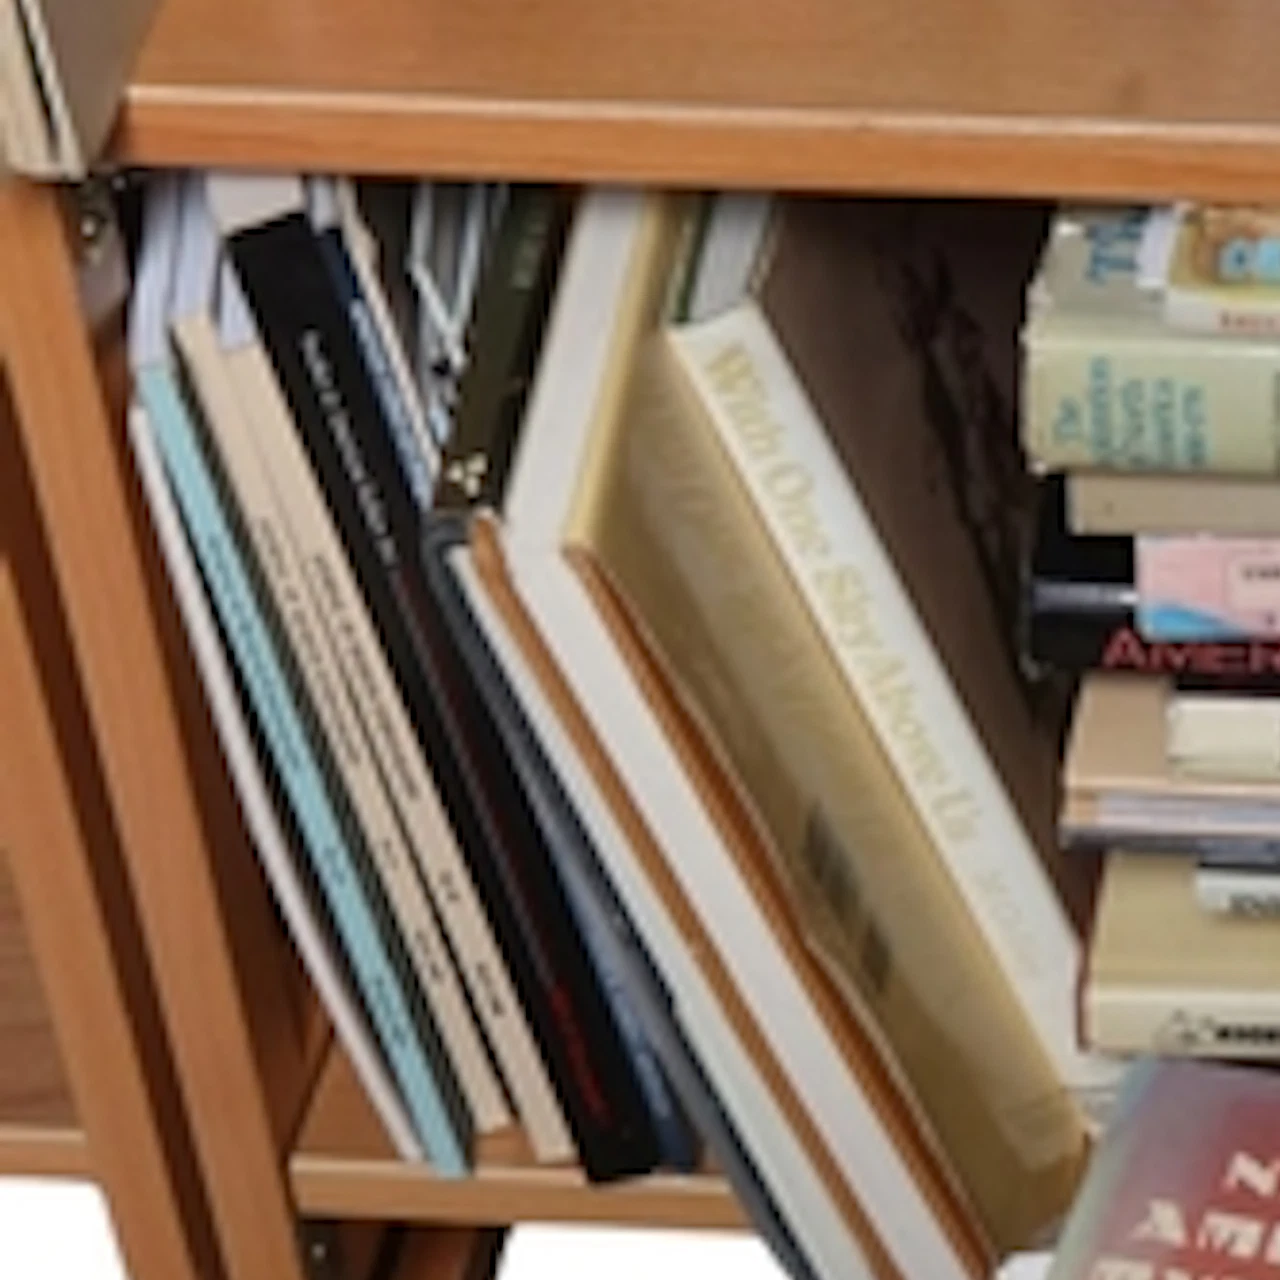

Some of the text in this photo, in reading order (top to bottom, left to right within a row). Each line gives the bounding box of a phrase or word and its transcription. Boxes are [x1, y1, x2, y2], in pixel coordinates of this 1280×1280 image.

[700, 340, 984, 847] With One Sky Above Us
